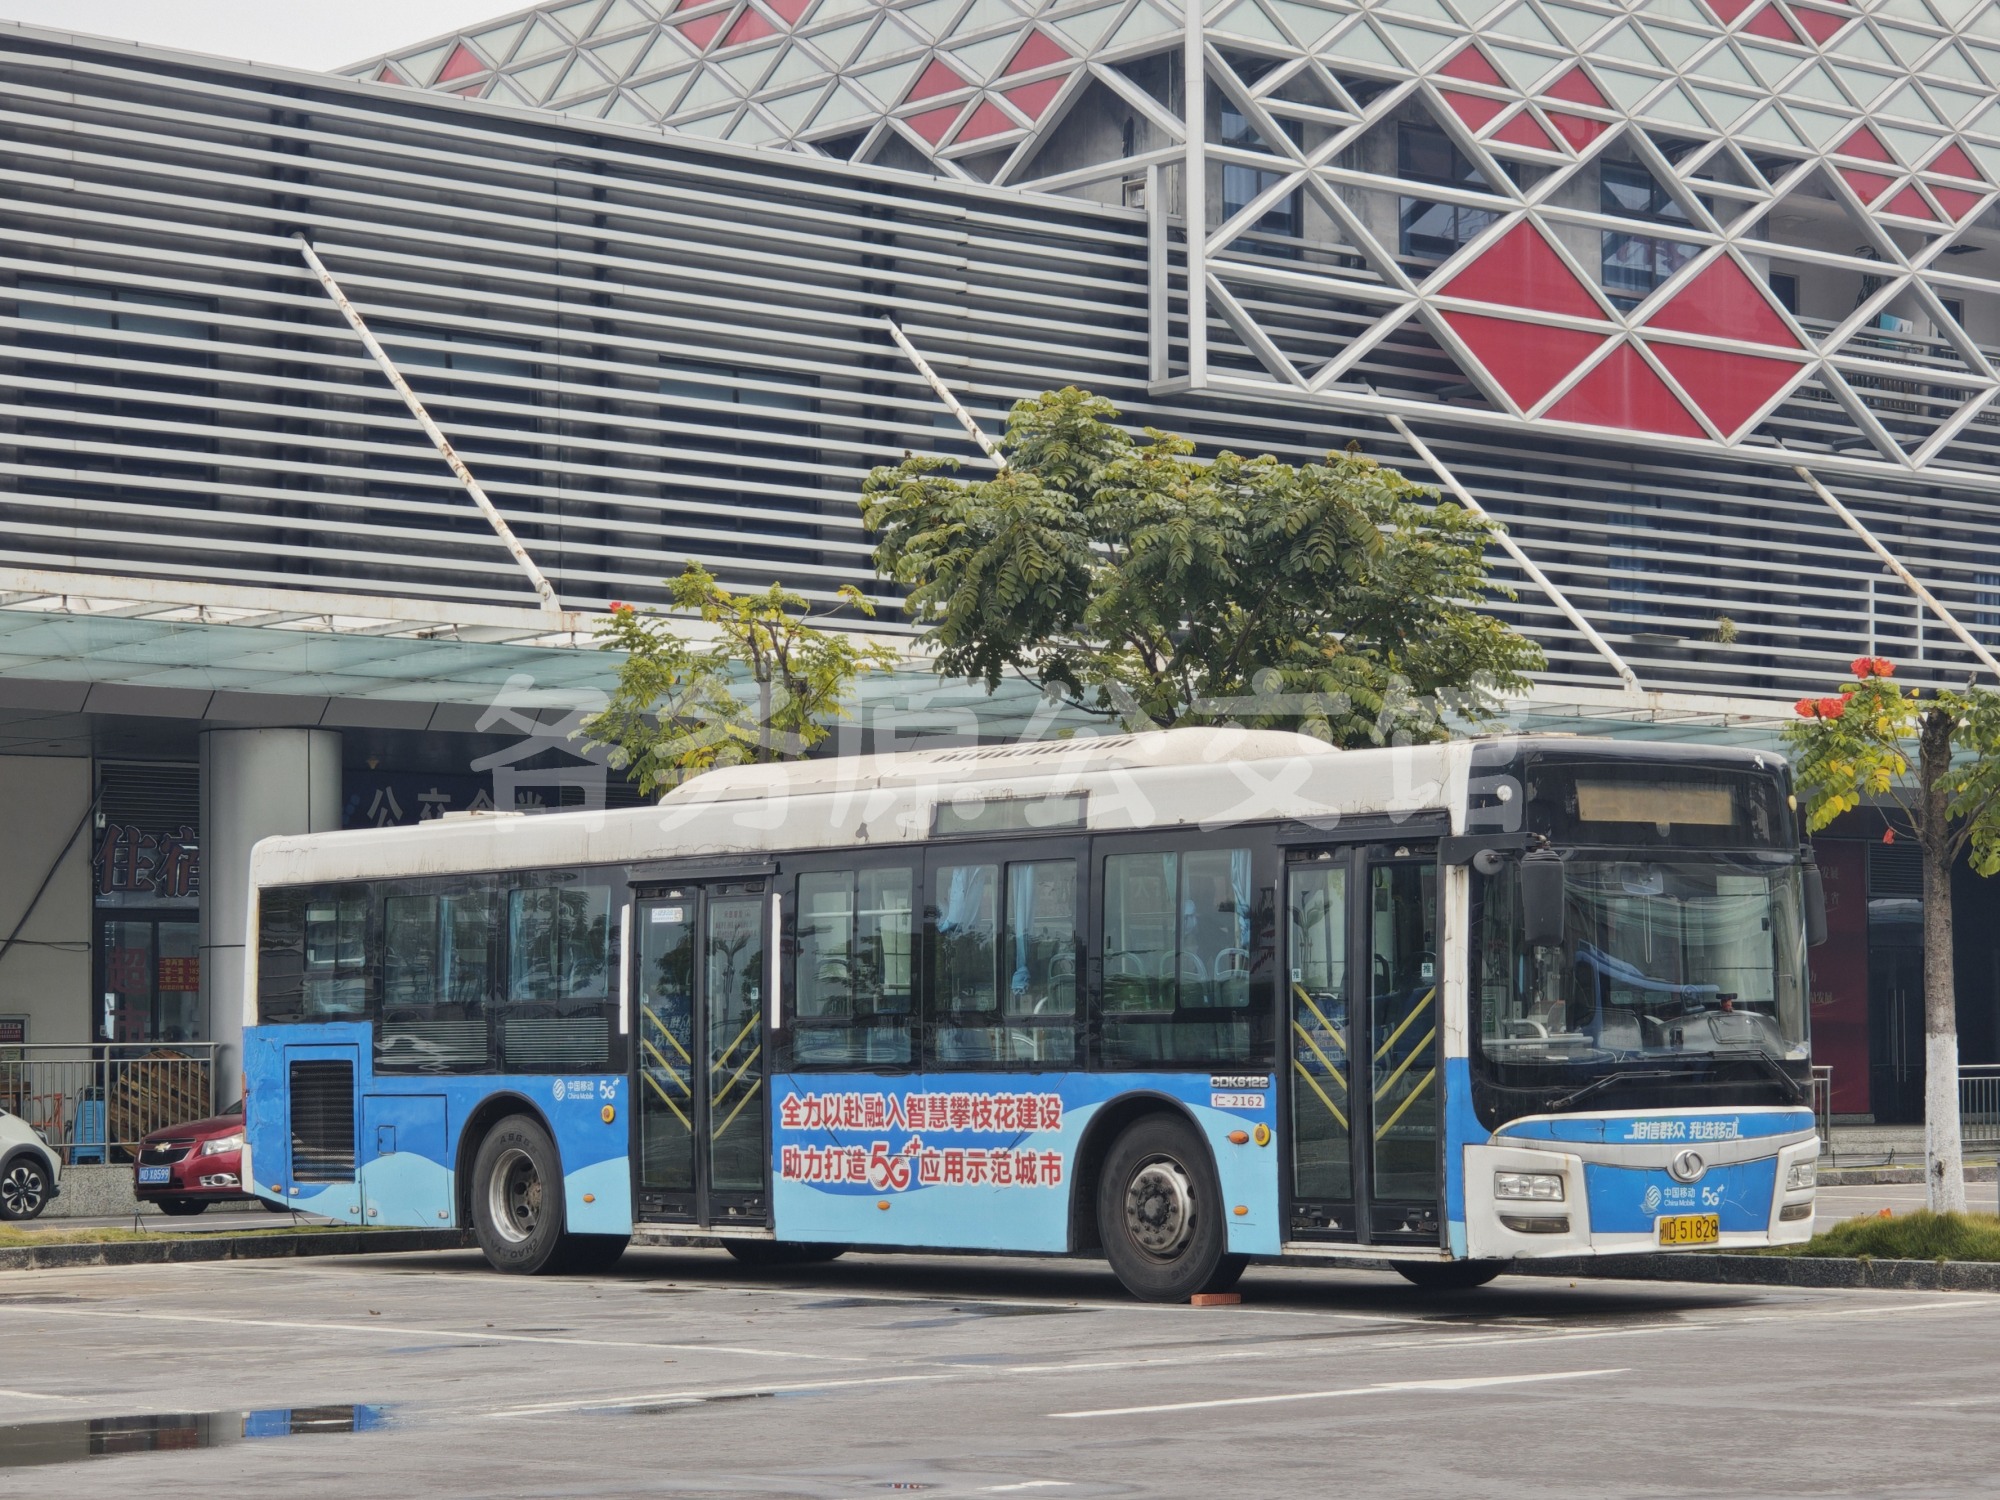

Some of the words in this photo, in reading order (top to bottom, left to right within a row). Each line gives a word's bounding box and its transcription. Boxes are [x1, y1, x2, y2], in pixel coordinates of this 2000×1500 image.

[94, 824, 200, 897] 住宿
[567, 1080, 594, 1092] 中国移动
[1210, 1076, 1269, 1088] CDK6122
[567, 1092, 580, 1100] China
[580, 1092, 595, 1100] Mobile
[780, 1092, 1063, 1132] 全力以赴融入智慧攀枝花建设
[1624, 1121, 1686, 1140] 相信群众
[1689, 1116, 1743, 1139] 我选移动
[1664, 1187, 1696, 1199] 中国移动
[1679, 1199, 1696, 1207] Mobile
